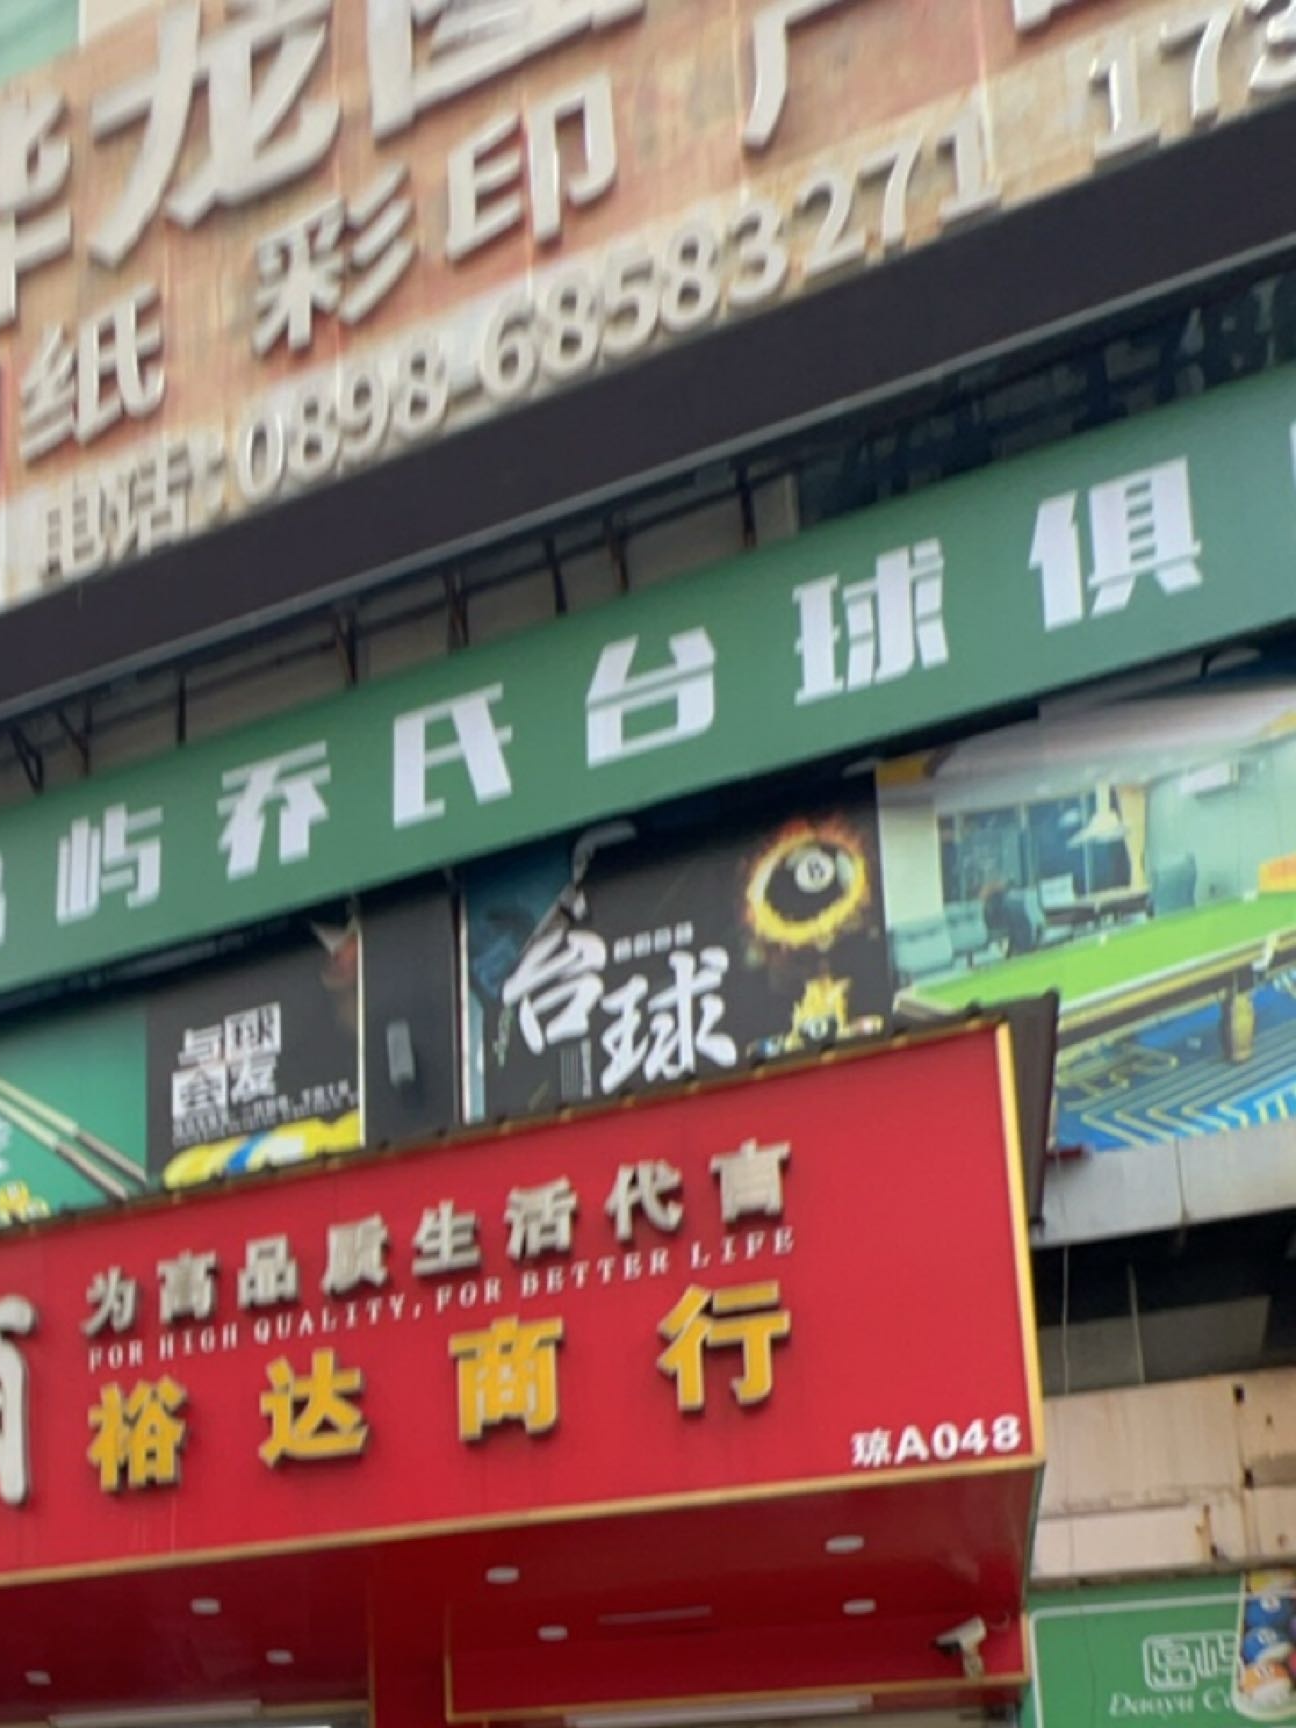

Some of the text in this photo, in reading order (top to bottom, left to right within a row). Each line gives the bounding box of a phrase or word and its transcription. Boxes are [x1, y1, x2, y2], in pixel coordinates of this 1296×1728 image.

[252, 72, 618, 357] 彩印
[502, 926, 738, 1095] 台球
[80, 1135, 792, 1337] 为高品质生活代言
[88, 1339, 144, 1374] FOR
[159, 1322, 239, 1362] HIGH
[436, 1278, 505, 1313] FOR
[520, 1247, 670, 1300] BETTER
[690, 1225, 796, 1269] LIFE
[88, 1281, 794, 1494] 裕达商行
